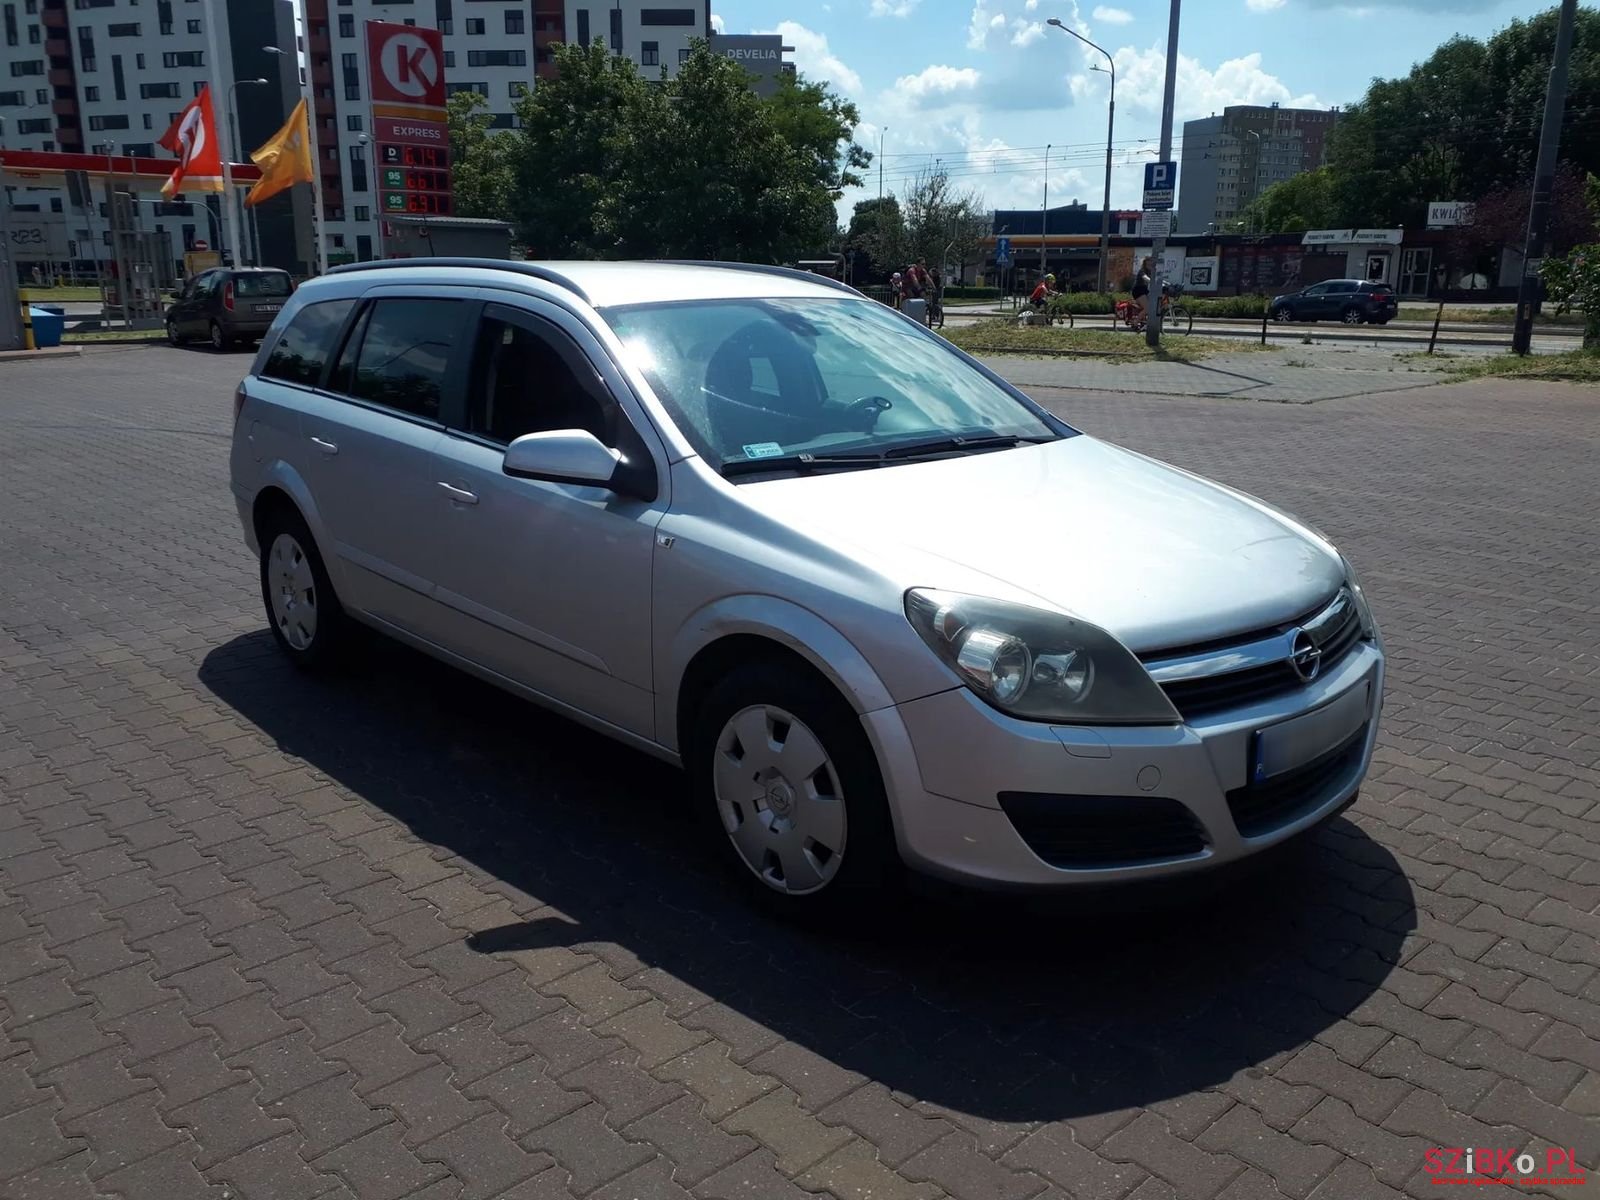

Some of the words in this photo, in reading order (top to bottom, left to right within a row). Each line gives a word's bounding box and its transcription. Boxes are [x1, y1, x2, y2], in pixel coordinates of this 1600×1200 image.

[727, 49, 777, 60] DEVELIA
[393, 126, 440, 139] EXPRESS
[388, 148, 396, 156] D
[388, 172, 400, 180] 95
[1152, 165, 1167, 187] P
[390, 196, 402, 204] 95
